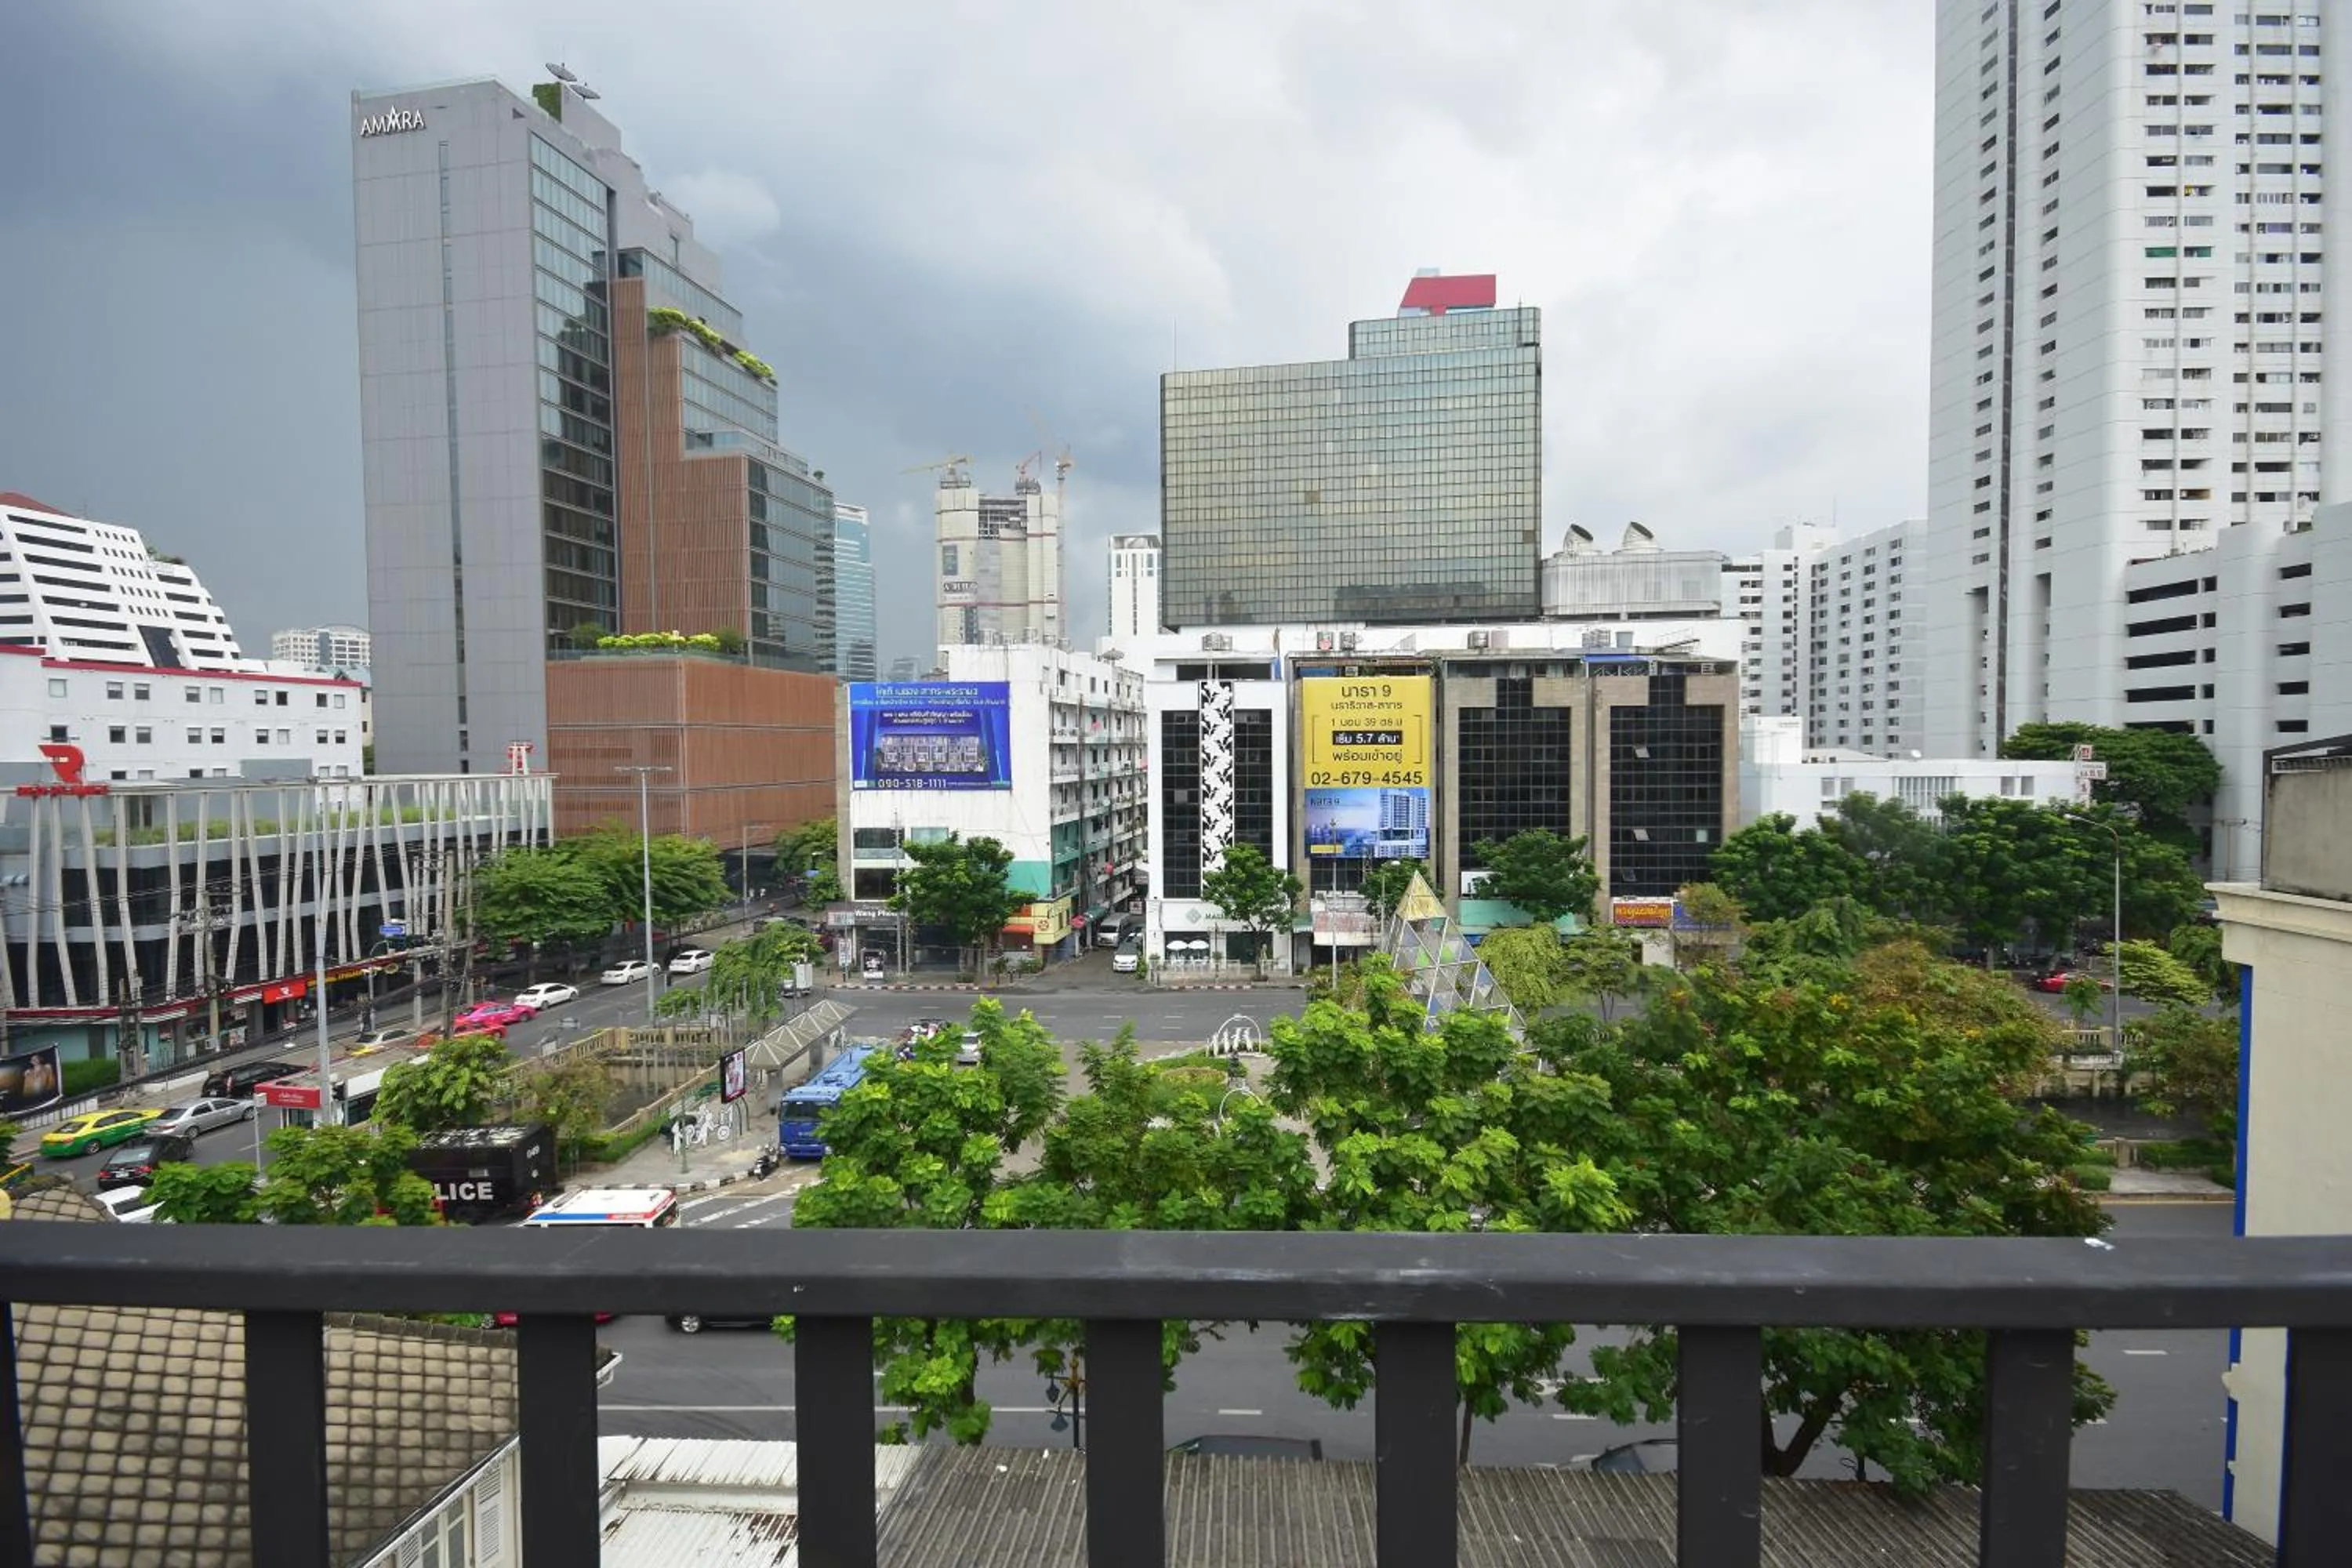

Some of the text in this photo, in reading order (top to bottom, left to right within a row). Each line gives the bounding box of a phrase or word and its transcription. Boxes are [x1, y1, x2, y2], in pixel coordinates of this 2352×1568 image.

[360, 105, 424, 136] AMARA
[1341, 684, 1392, 698] นารา 9
[1356, 733, 1374, 744] 5.7
[1332, 748, 1403, 764] พร้อมเข้าอยู่
[1310, 771, 1424, 786] 02-679-4545
[433, 1181, 494, 1201] LICE
